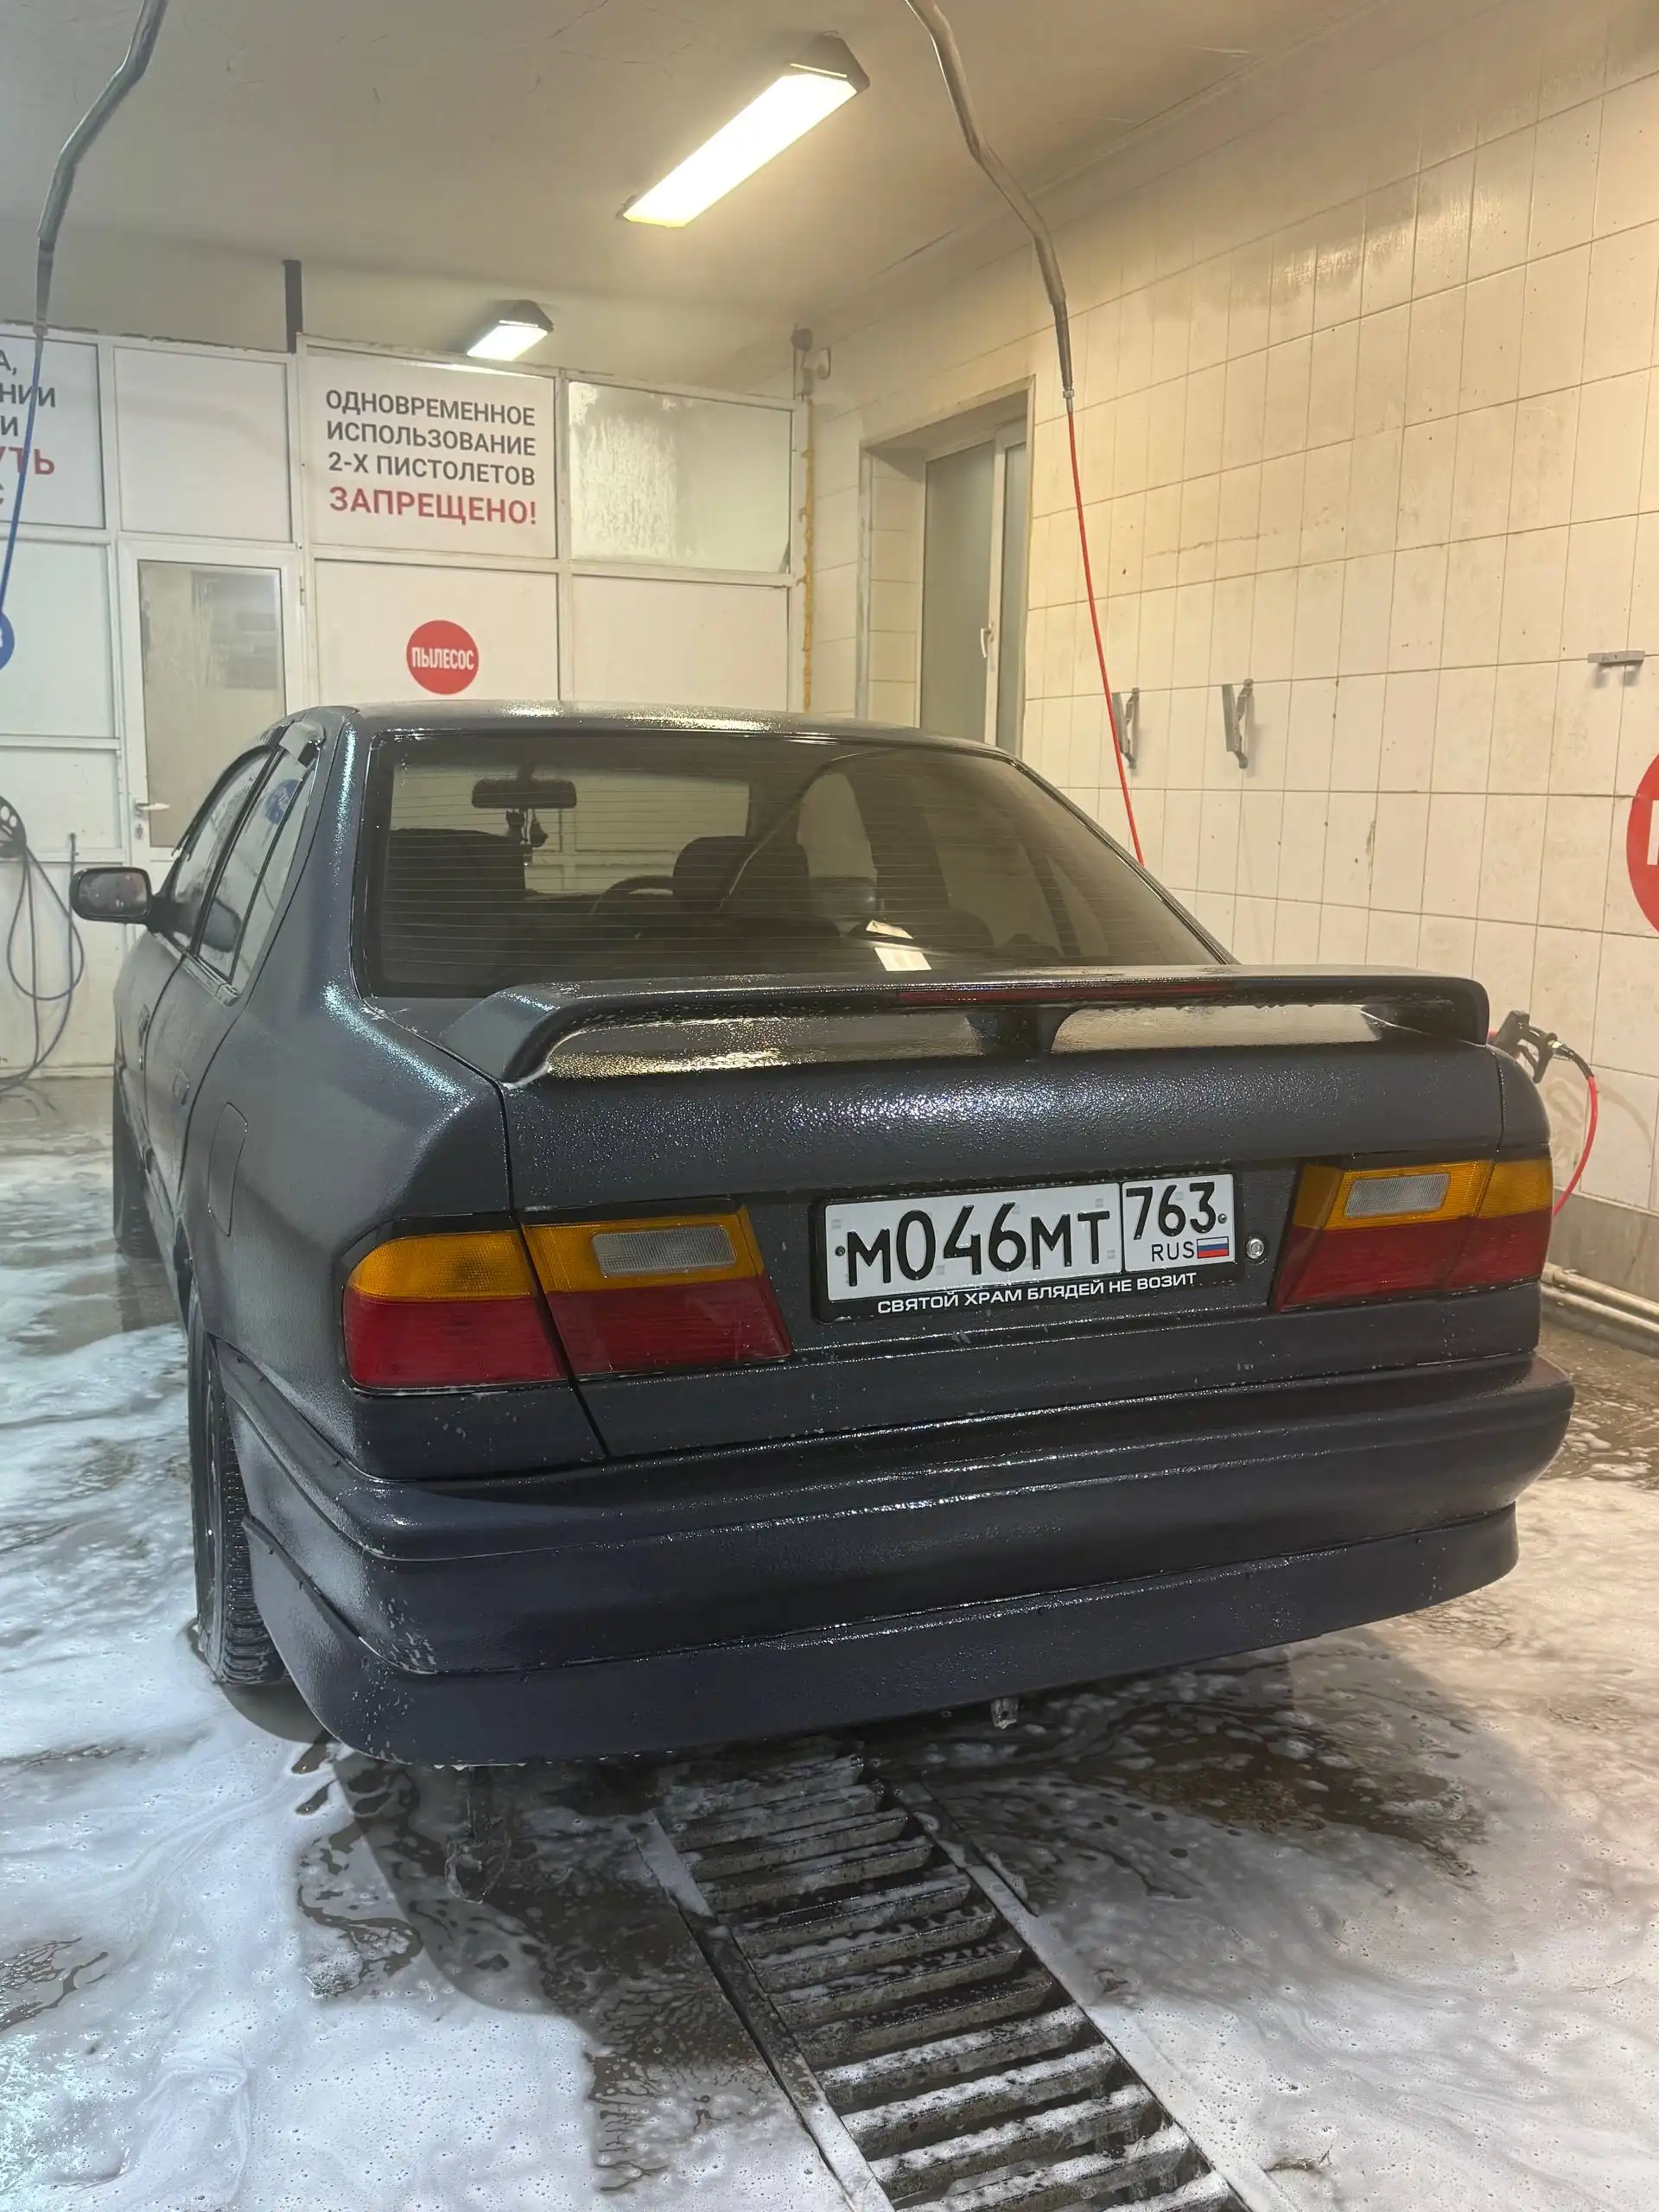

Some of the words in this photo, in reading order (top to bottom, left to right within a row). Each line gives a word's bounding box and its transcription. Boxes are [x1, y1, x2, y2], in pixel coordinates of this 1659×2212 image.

[326, 390, 536, 426] ОДНОВРЕМЕННОЕ
[327, 420, 536, 456] ИСПОЛЬЗОВАНИЕ
[328, 452, 369, 474] 2-Х
[377, 454, 536, 486] ПИСТОЛЕТОВ
[329, 486, 537, 525] ЗАПРЕЩЕНО!
[411, 646, 474, 671] ПЫЛЕСОС
[1126, 1181, 1217, 1241] 763
[1151, 1240, 1195, 1262] RUS
[877, 1292, 959, 1314] СВЯТОЙ
[963, 1289, 1022, 1306] ХРАМ
[1027, 1279, 1104, 1300] БЛЯДЕЙ
[1109, 1281, 1132, 1293] НЕ
[1137, 1272, 1198, 1292] ВОЗИТ
